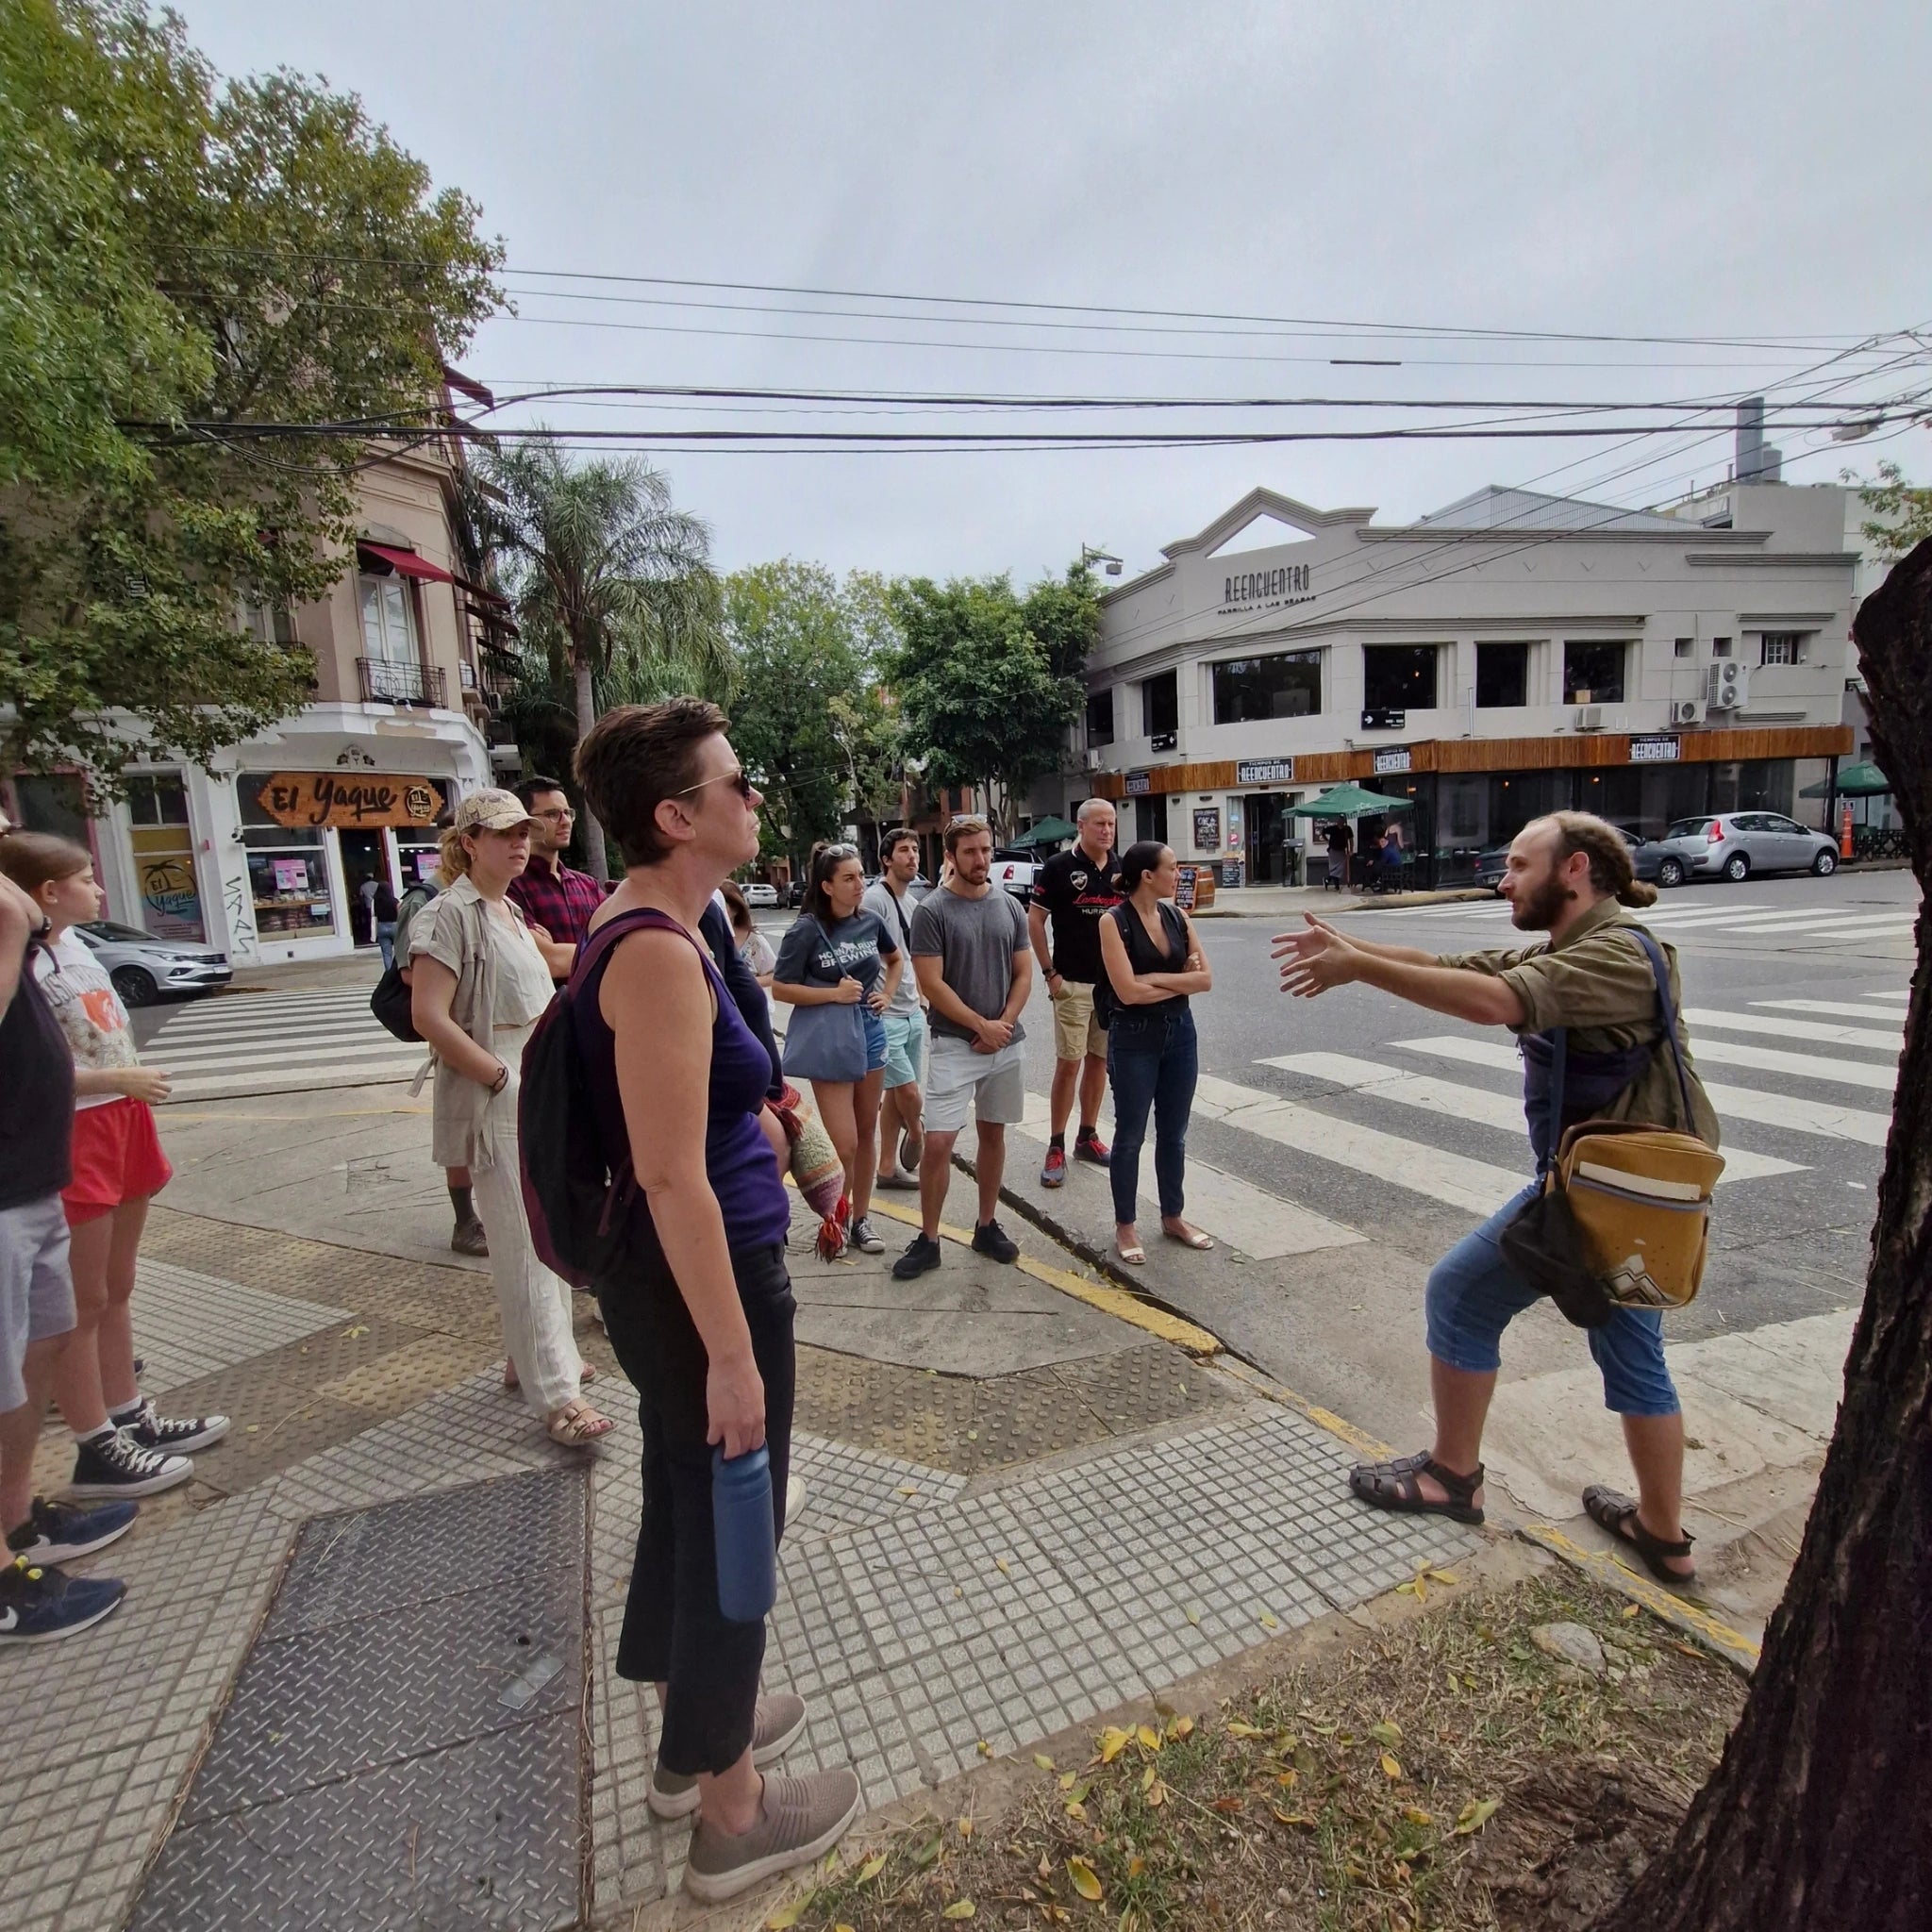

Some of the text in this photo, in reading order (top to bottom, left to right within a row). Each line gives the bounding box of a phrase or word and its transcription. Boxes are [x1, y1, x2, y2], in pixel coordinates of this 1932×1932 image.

[1224, 564, 1309, 603] REENCUENTRO
[1241, 763, 1290, 782] REENCUENTRO
[272, 776, 397, 824] El Yaque
